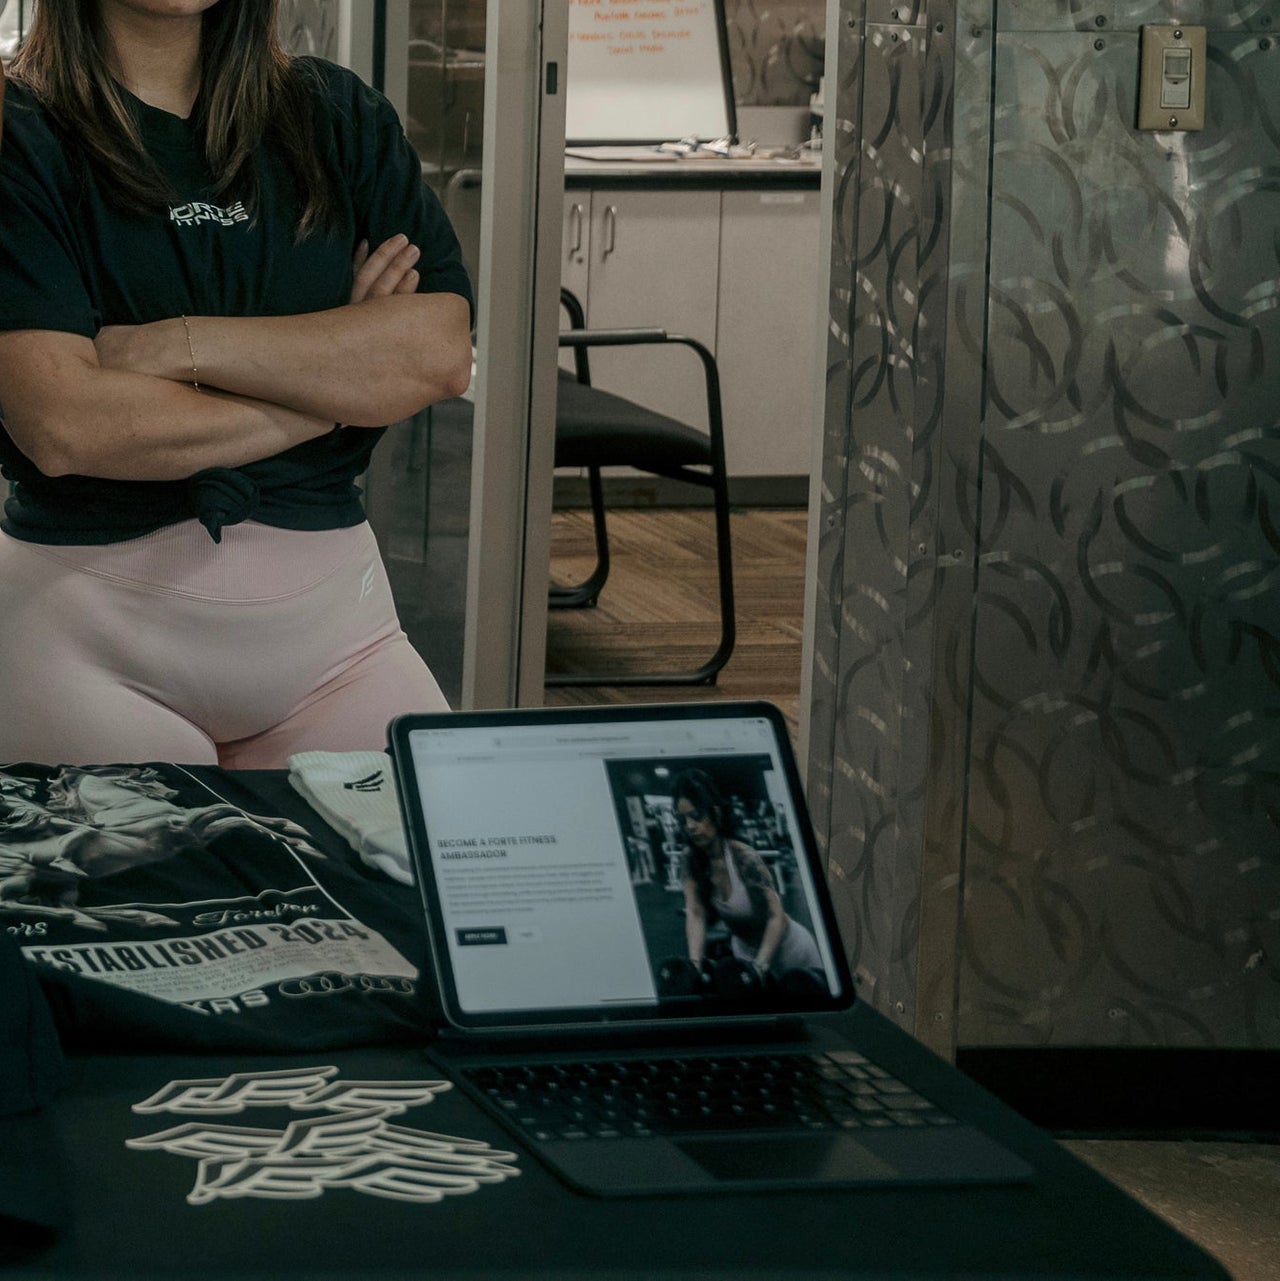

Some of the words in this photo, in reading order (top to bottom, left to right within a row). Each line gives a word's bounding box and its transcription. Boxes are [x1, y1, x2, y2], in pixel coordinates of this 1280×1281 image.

[437, 838, 477, 848] BECOME
[479, 837, 486, 846] A
[489, 836, 519, 846] FORTE
[519, 835, 557, 845] FITNESS
[440, 849, 507, 860] AMBASSADOR
[267, 920, 371, 944] 2024
